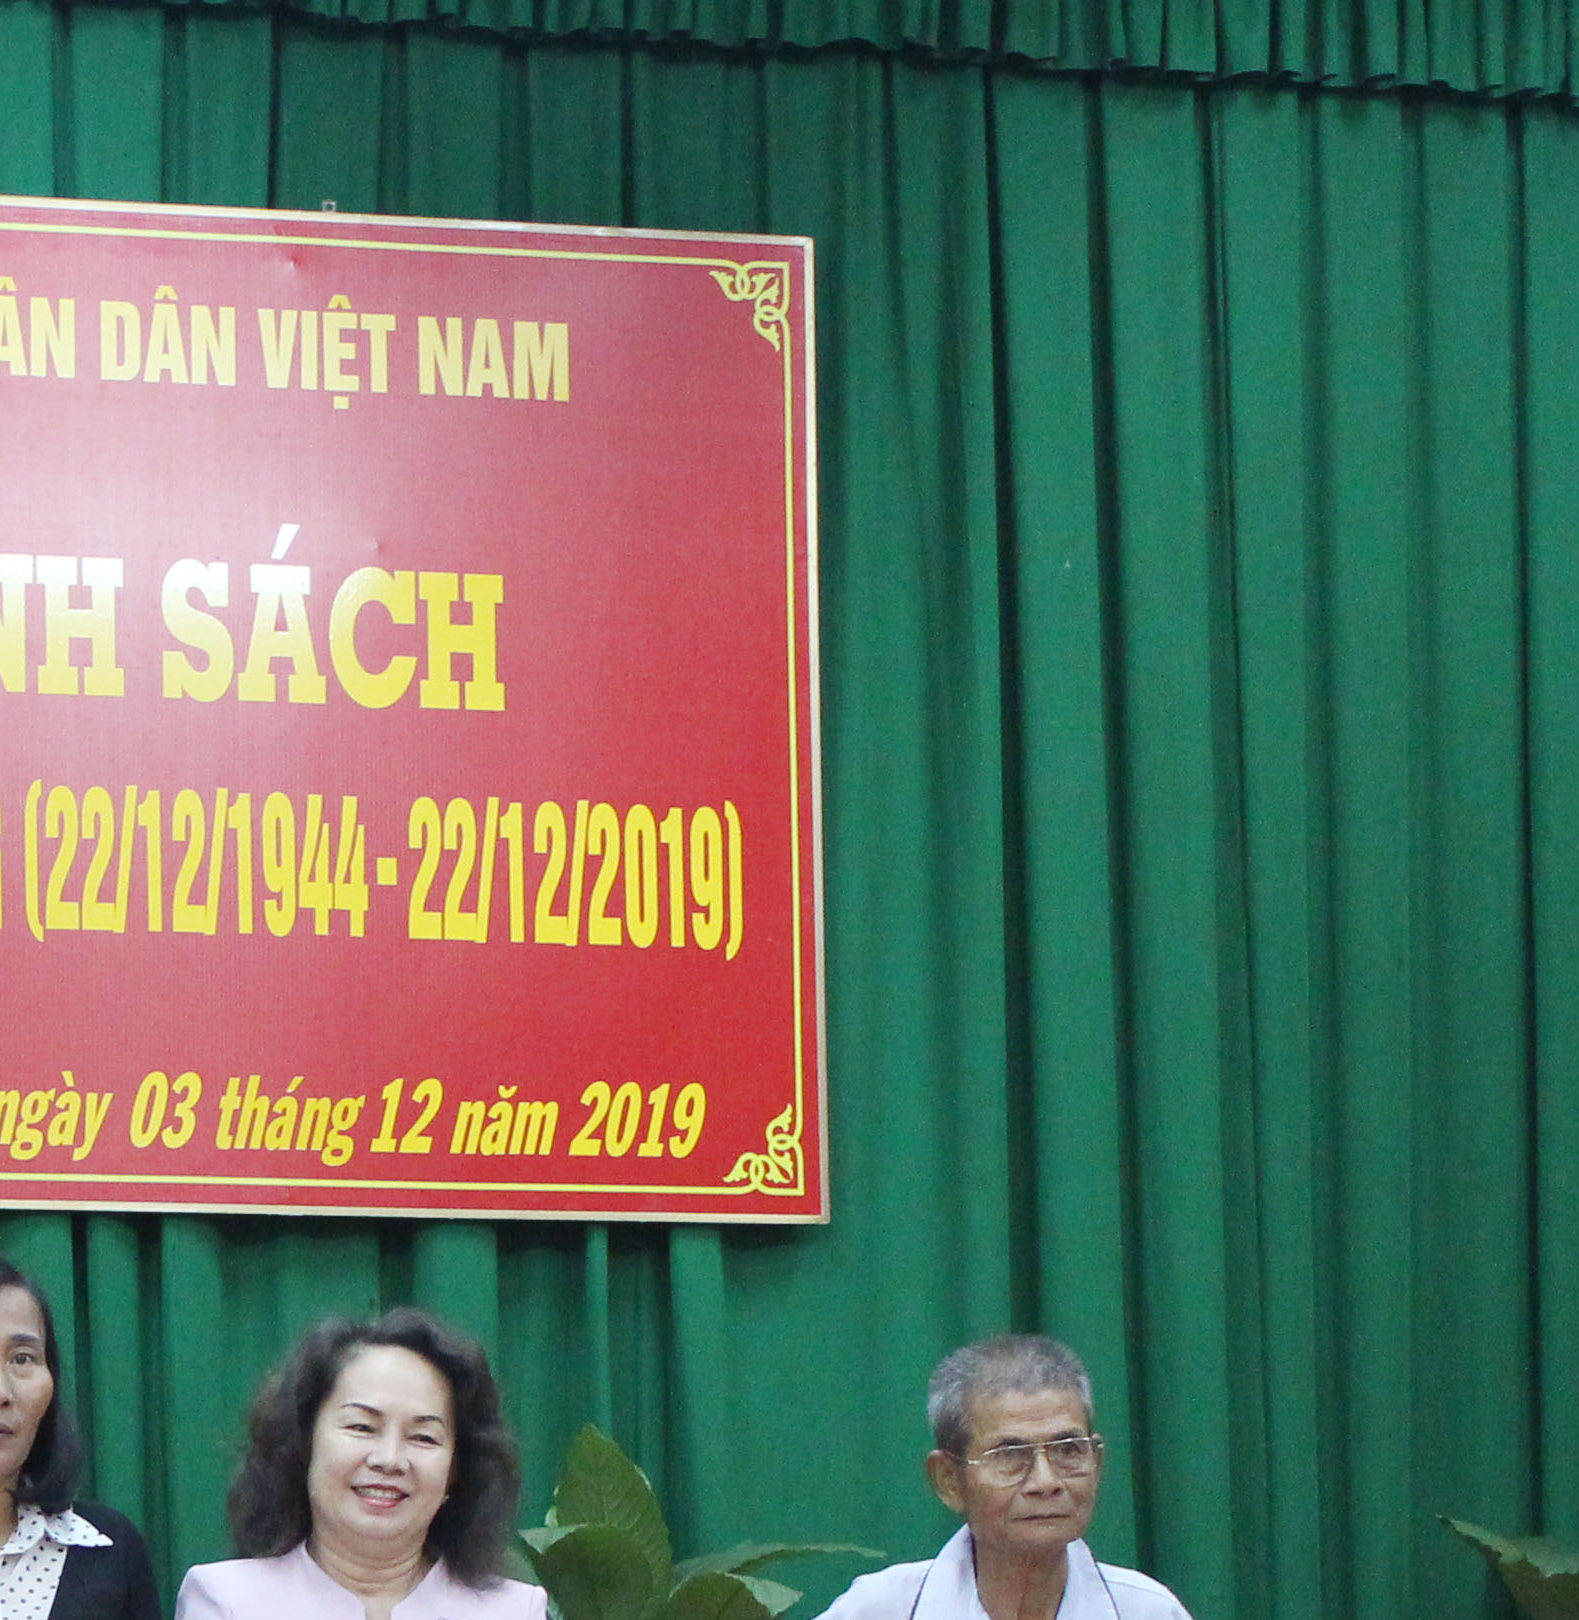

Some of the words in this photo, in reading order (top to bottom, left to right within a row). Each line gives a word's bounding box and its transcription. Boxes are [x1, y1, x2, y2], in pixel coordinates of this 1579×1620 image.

[102, 294, 236, 387] DÂN
[257, 296, 395, 410] VIỆT
[418, 316, 570, 401] NAM
[162, 524, 506, 712] SÁCH
[130, 1071, 201, 1150] 03
[216, 1076, 362, 1166] tháng
[372, 1079, 441, 1155] 12
[452, 1085, 551, 1157] năm
[569, 1080, 705, 1159] 2019
